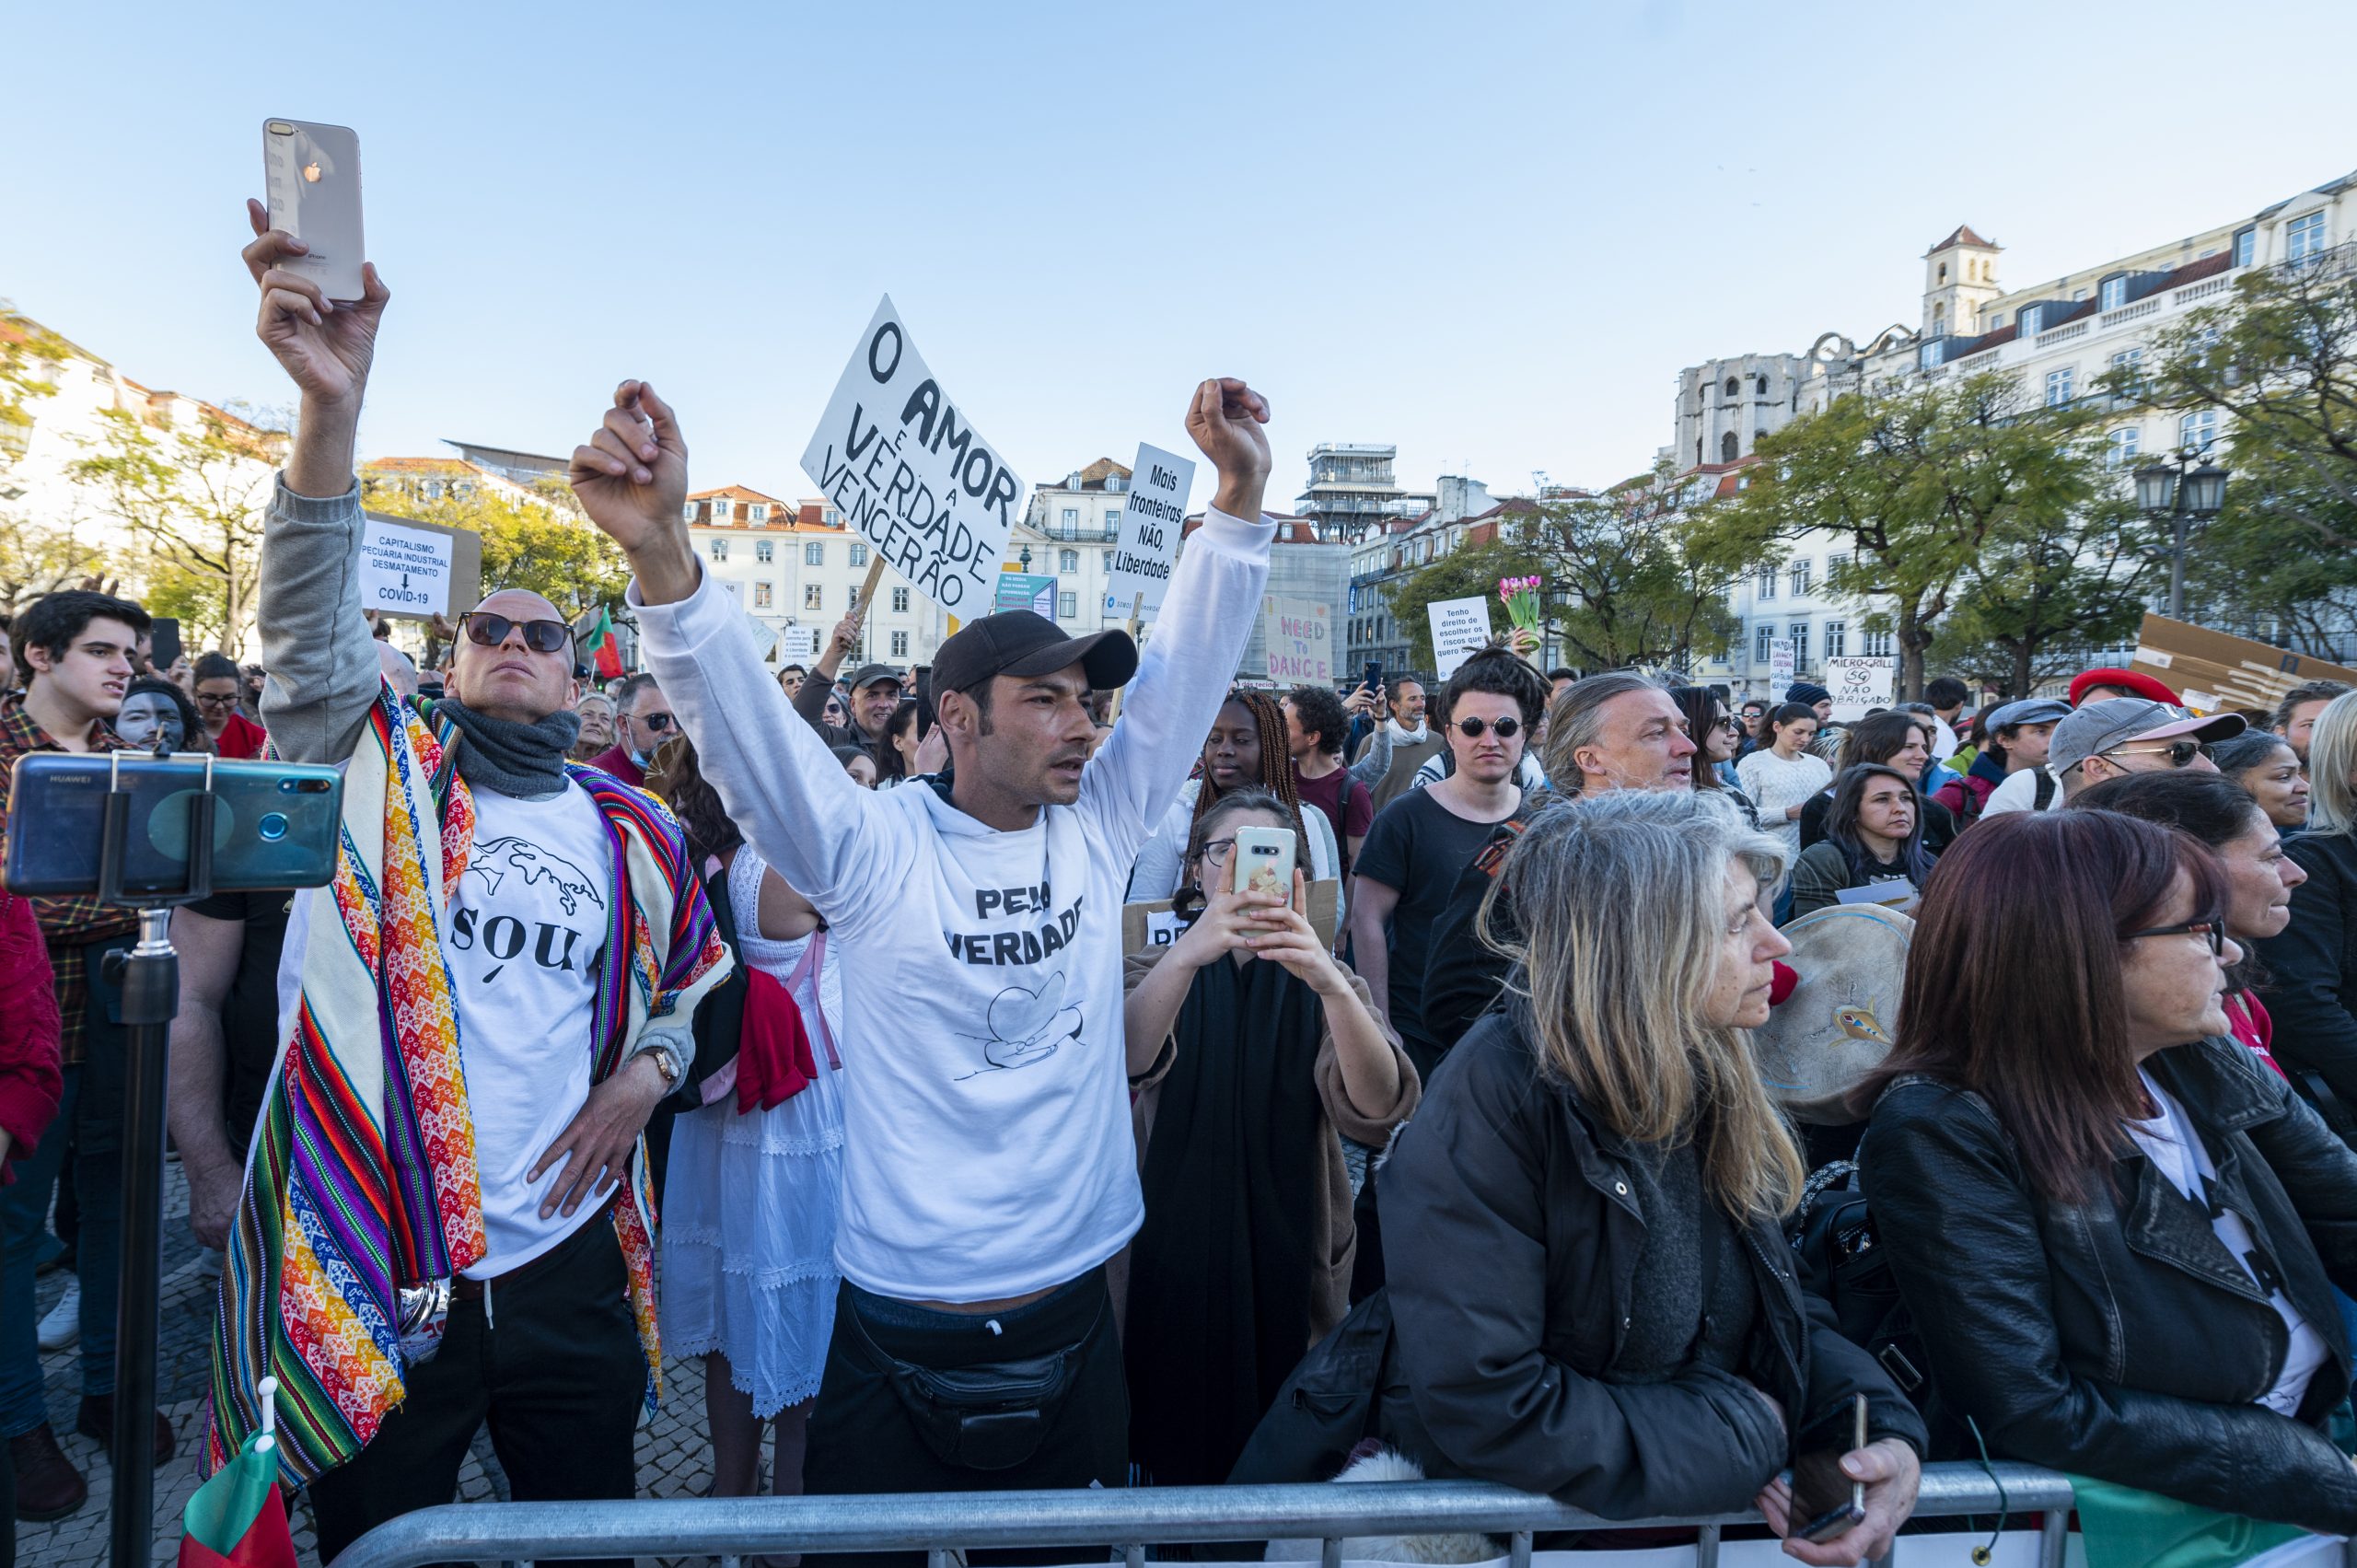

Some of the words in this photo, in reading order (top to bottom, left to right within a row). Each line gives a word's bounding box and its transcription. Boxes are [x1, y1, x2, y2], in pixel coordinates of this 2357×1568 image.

[868, 320, 903, 385] O
[900, 377, 1016, 528] AMOR
[1149, 463, 1178, 493] Mais
[844, 401, 995, 586] VERDADE
[1129, 490, 1183, 525] fronteiras
[819, 444, 964, 607] VENCERÃO
[1137, 522, 1164, 552] NÃO,
[362, 544, 402, 560] PECUÁRIA
[404, 553, 448, 568] INDUSTRIAL
[378, 536, 435, 554] CAPITALISMO
[372, 558, 438, 577] DESMATAMENTO
[1115, 550, 1170, 580] Liberdade
[378, 587, 428, 604] COVID-19
[1441, 619, 1467, 627] direito
[1446, 609, 1469, 617] Tenho
[1281, 616, 1325, 640] NEED
[1439, 627, 1471, 637] escolher
[1437, 648, 1459, 657] quero
[1443, 638, 1466, 646] riscos
[1468, 636, 1482, 645] que
[1269, 652, 1328, 680] DANCE
[50, 775, 91, 784] HUAWEI
[976, 881, 1051, 920] PELA
